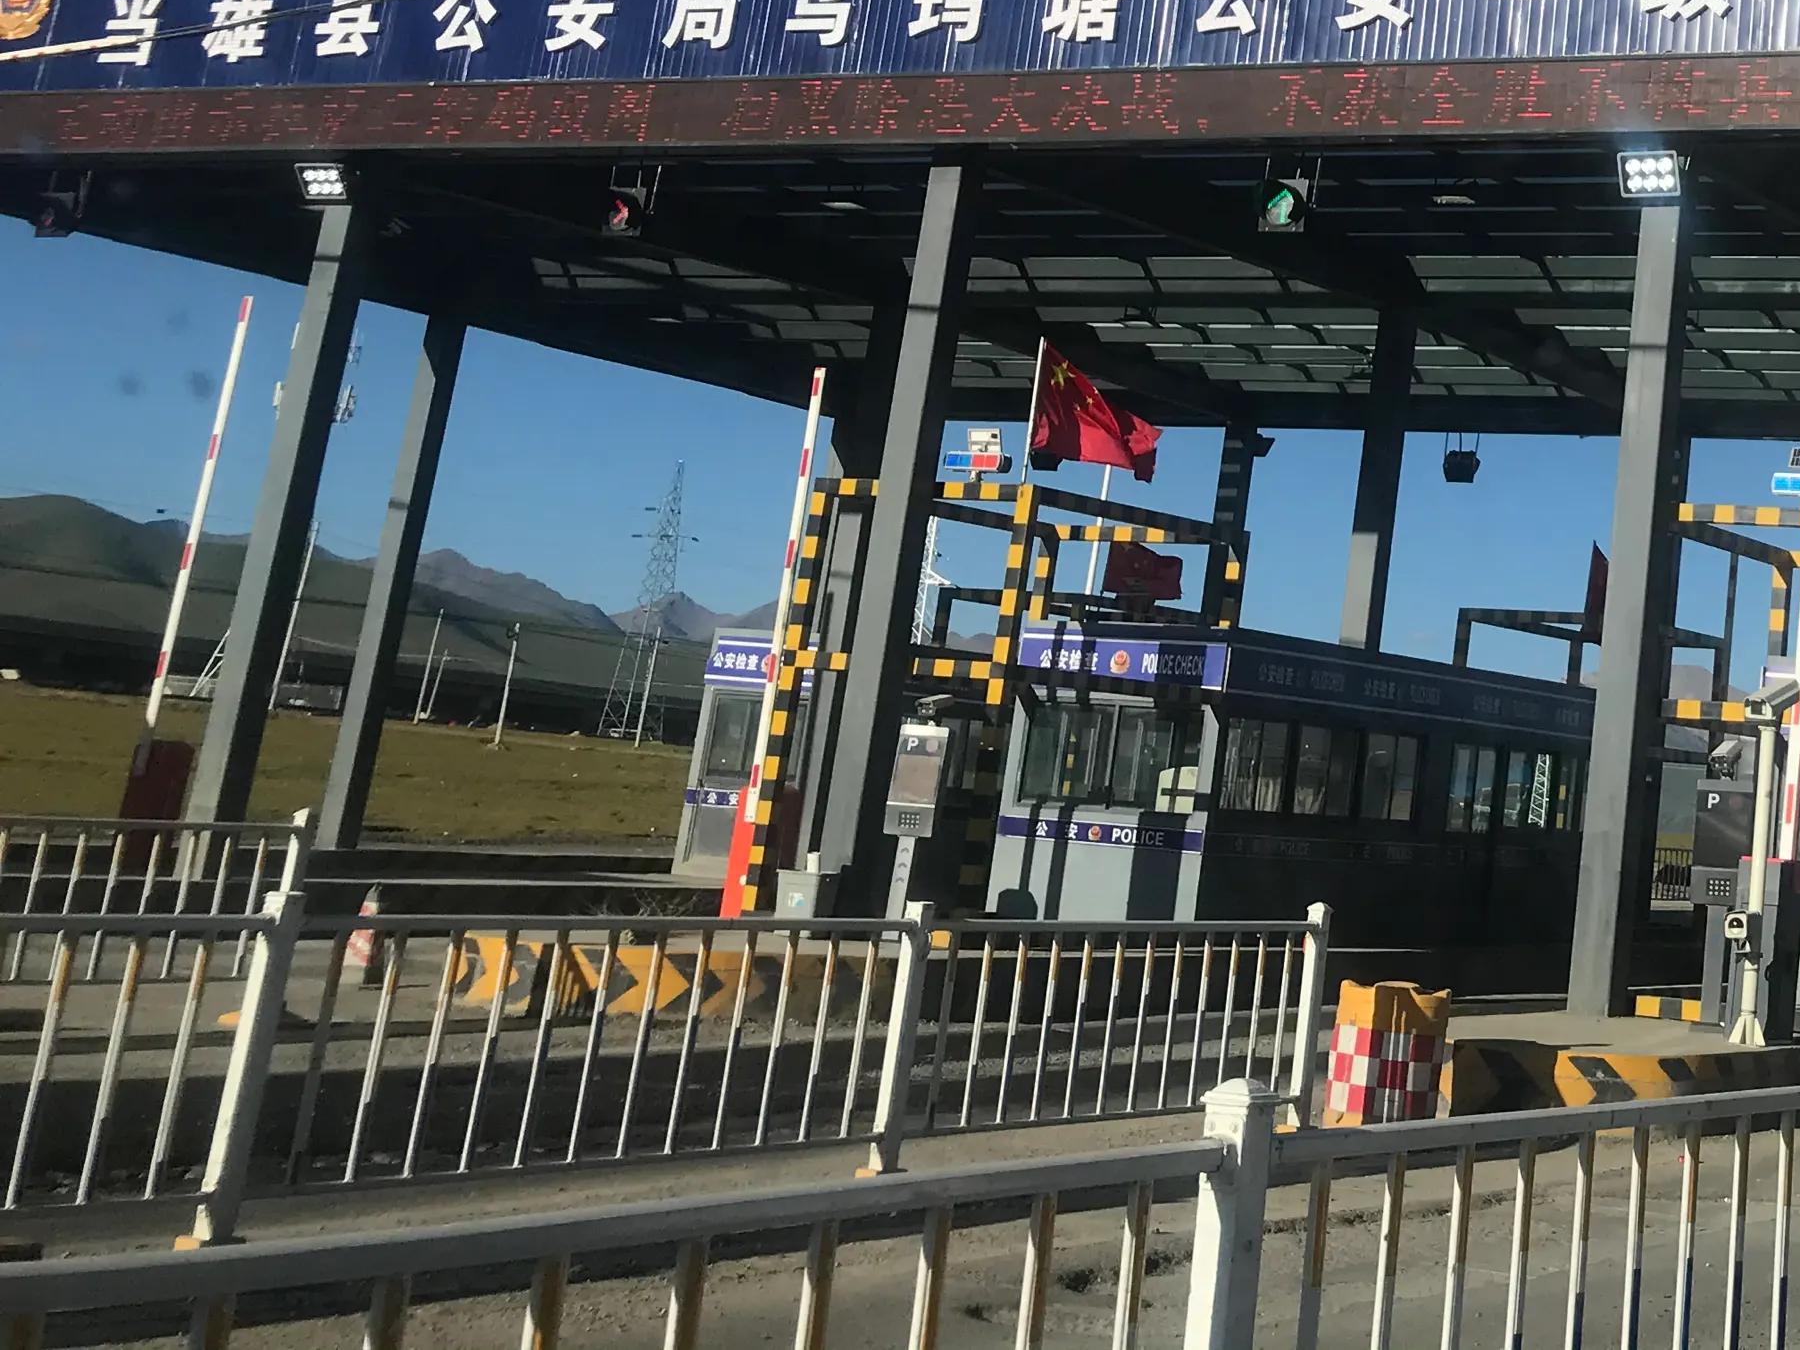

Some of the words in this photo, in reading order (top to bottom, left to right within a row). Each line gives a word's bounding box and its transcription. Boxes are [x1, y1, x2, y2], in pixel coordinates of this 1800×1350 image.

[713, 651, 759, 670] 公安检查
[1039, 649, 1098, 672] 公安检查
[1141, 653, 1174, 674] POLICE
[1175, 654, 1205, 676] CHECK
[907, 737, 919, 751] P
[1707, 793, 1720, 809] P
[1035, 821, 1079, 839] 公安
[1111, 828, 1165, 846] POLICE
